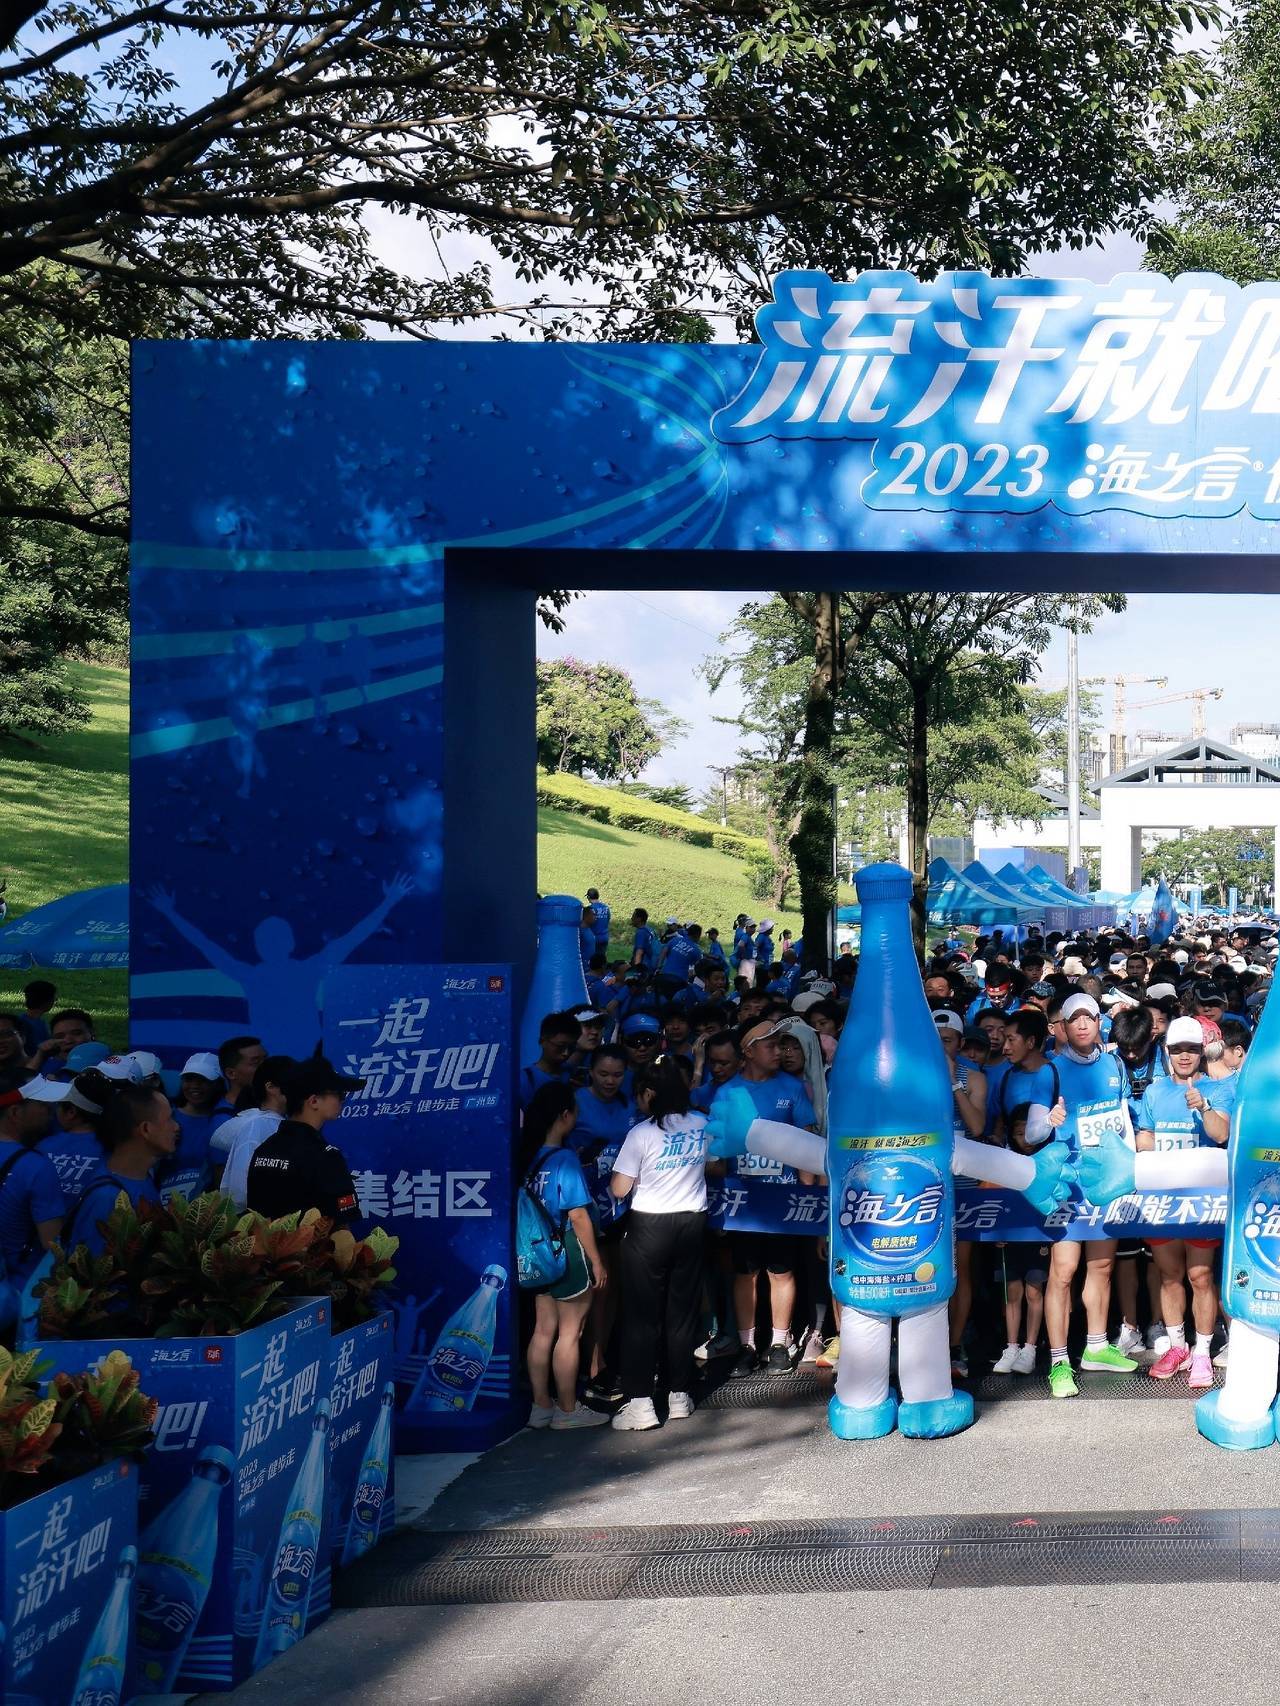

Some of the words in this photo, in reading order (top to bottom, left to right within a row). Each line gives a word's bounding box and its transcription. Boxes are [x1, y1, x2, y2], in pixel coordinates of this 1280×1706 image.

[881, 441, 1050, 497] 2023
[339, 998, 430, 1047] 一起
[338, 1105, 369, 1118] 023
[416, 1098, 460, 1113] 健步走
[350, 1169, 493, 1218] 集结区
[840, 1184, 943, 1227] 海之言
[240, 1330, 288, 1392] 一起
[238, 1359, 320, 1460] 流汗吧!
[239, 1458, 259, 1483] 2023
[267, 1447, 296, 1481] 健步走
[16, 1495, 73, 1560] 一起
[12, 1517, 112, 1627] 流汗吧!
[272, 1543, 316, 1579] 海之言
[48, 1606, 81, 1643] 健步走
